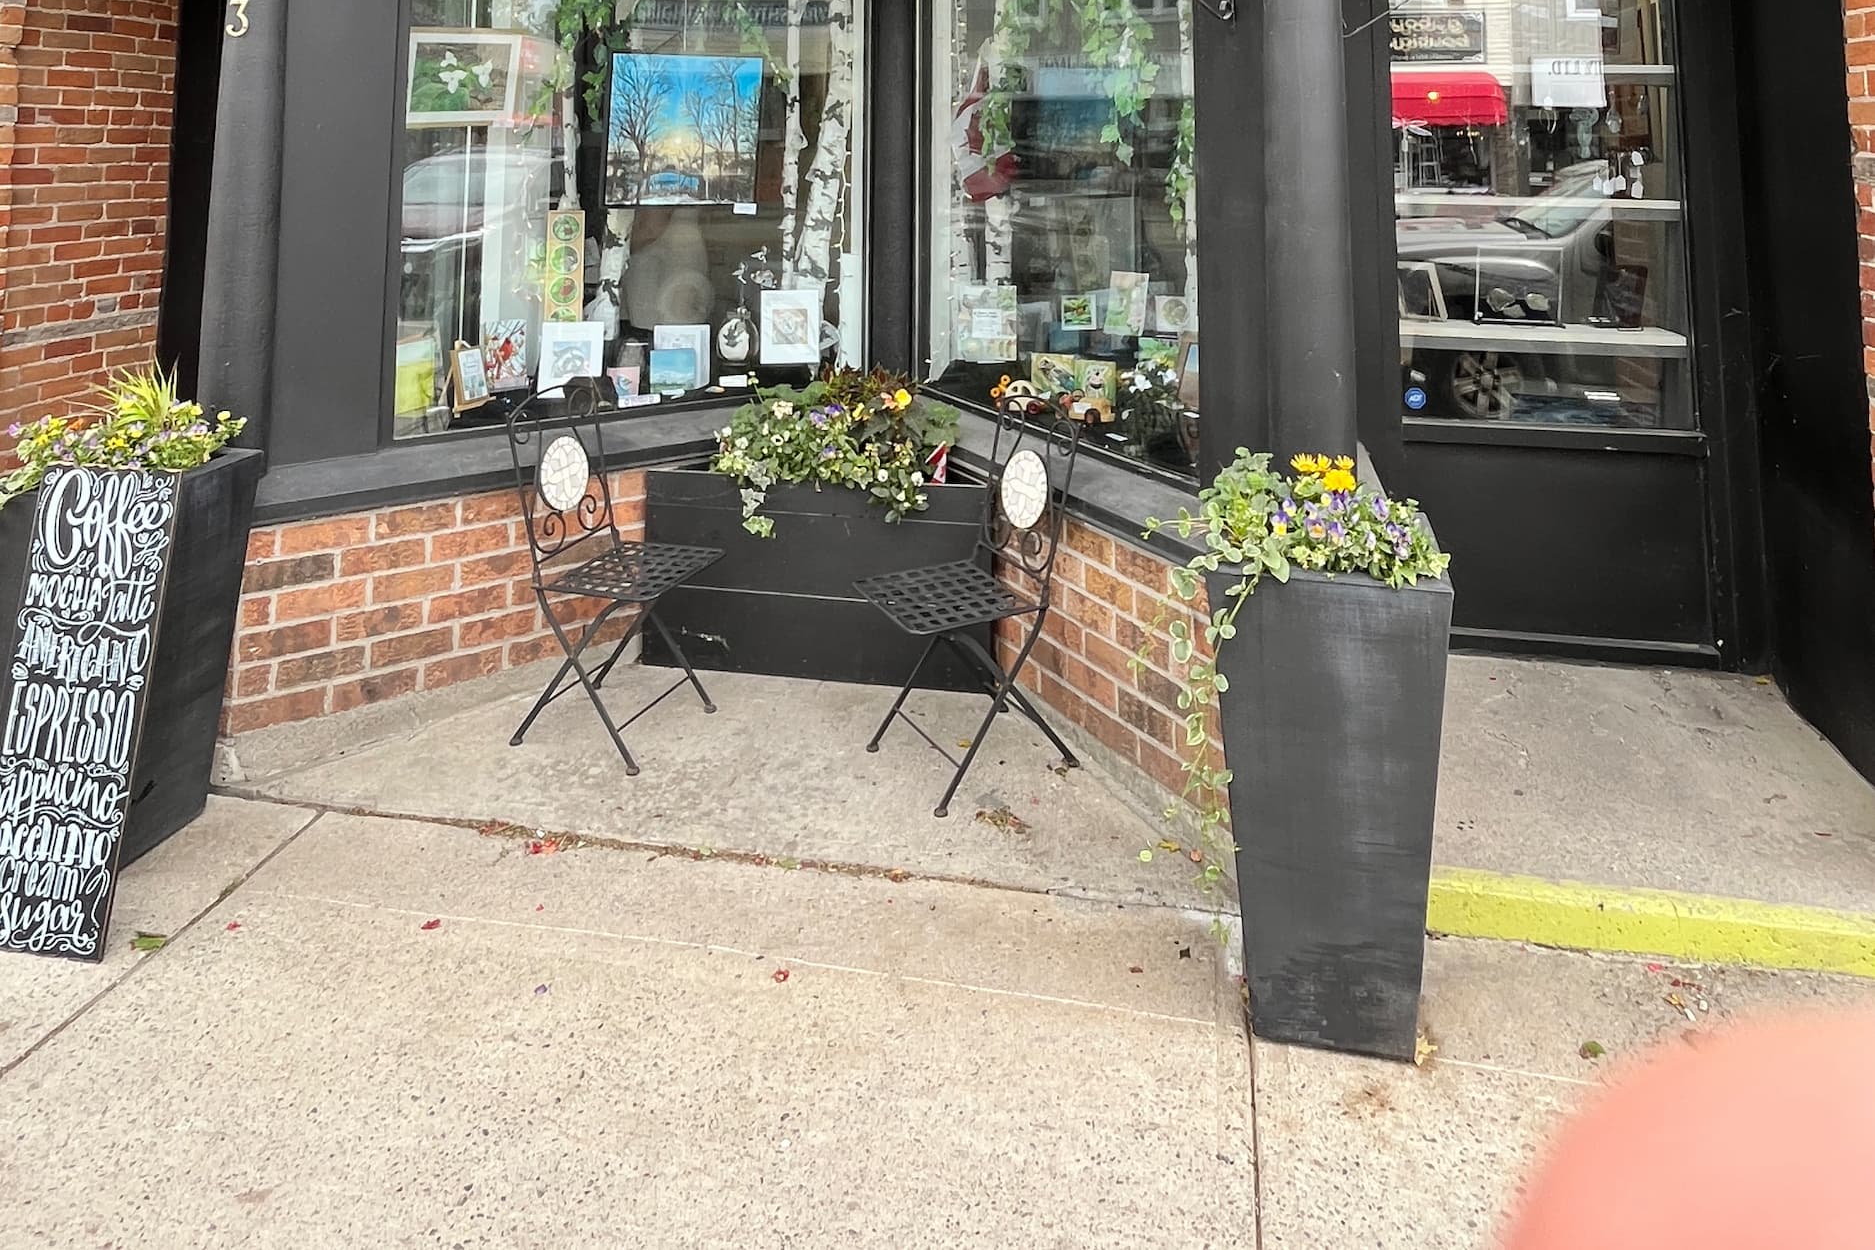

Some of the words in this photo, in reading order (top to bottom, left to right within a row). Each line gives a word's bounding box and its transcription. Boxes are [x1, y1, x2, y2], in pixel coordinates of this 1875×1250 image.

[46, 468, 170, 579] Coffee
[25, 573, 102, 612] MOCHA
[14, 617, 150, 690] AMERICANO
[3, 680, 136, 769] ESPRESSO
[0, 766, 129, 826] appucino
[0, 814, 112, 870] ACCHIATO
